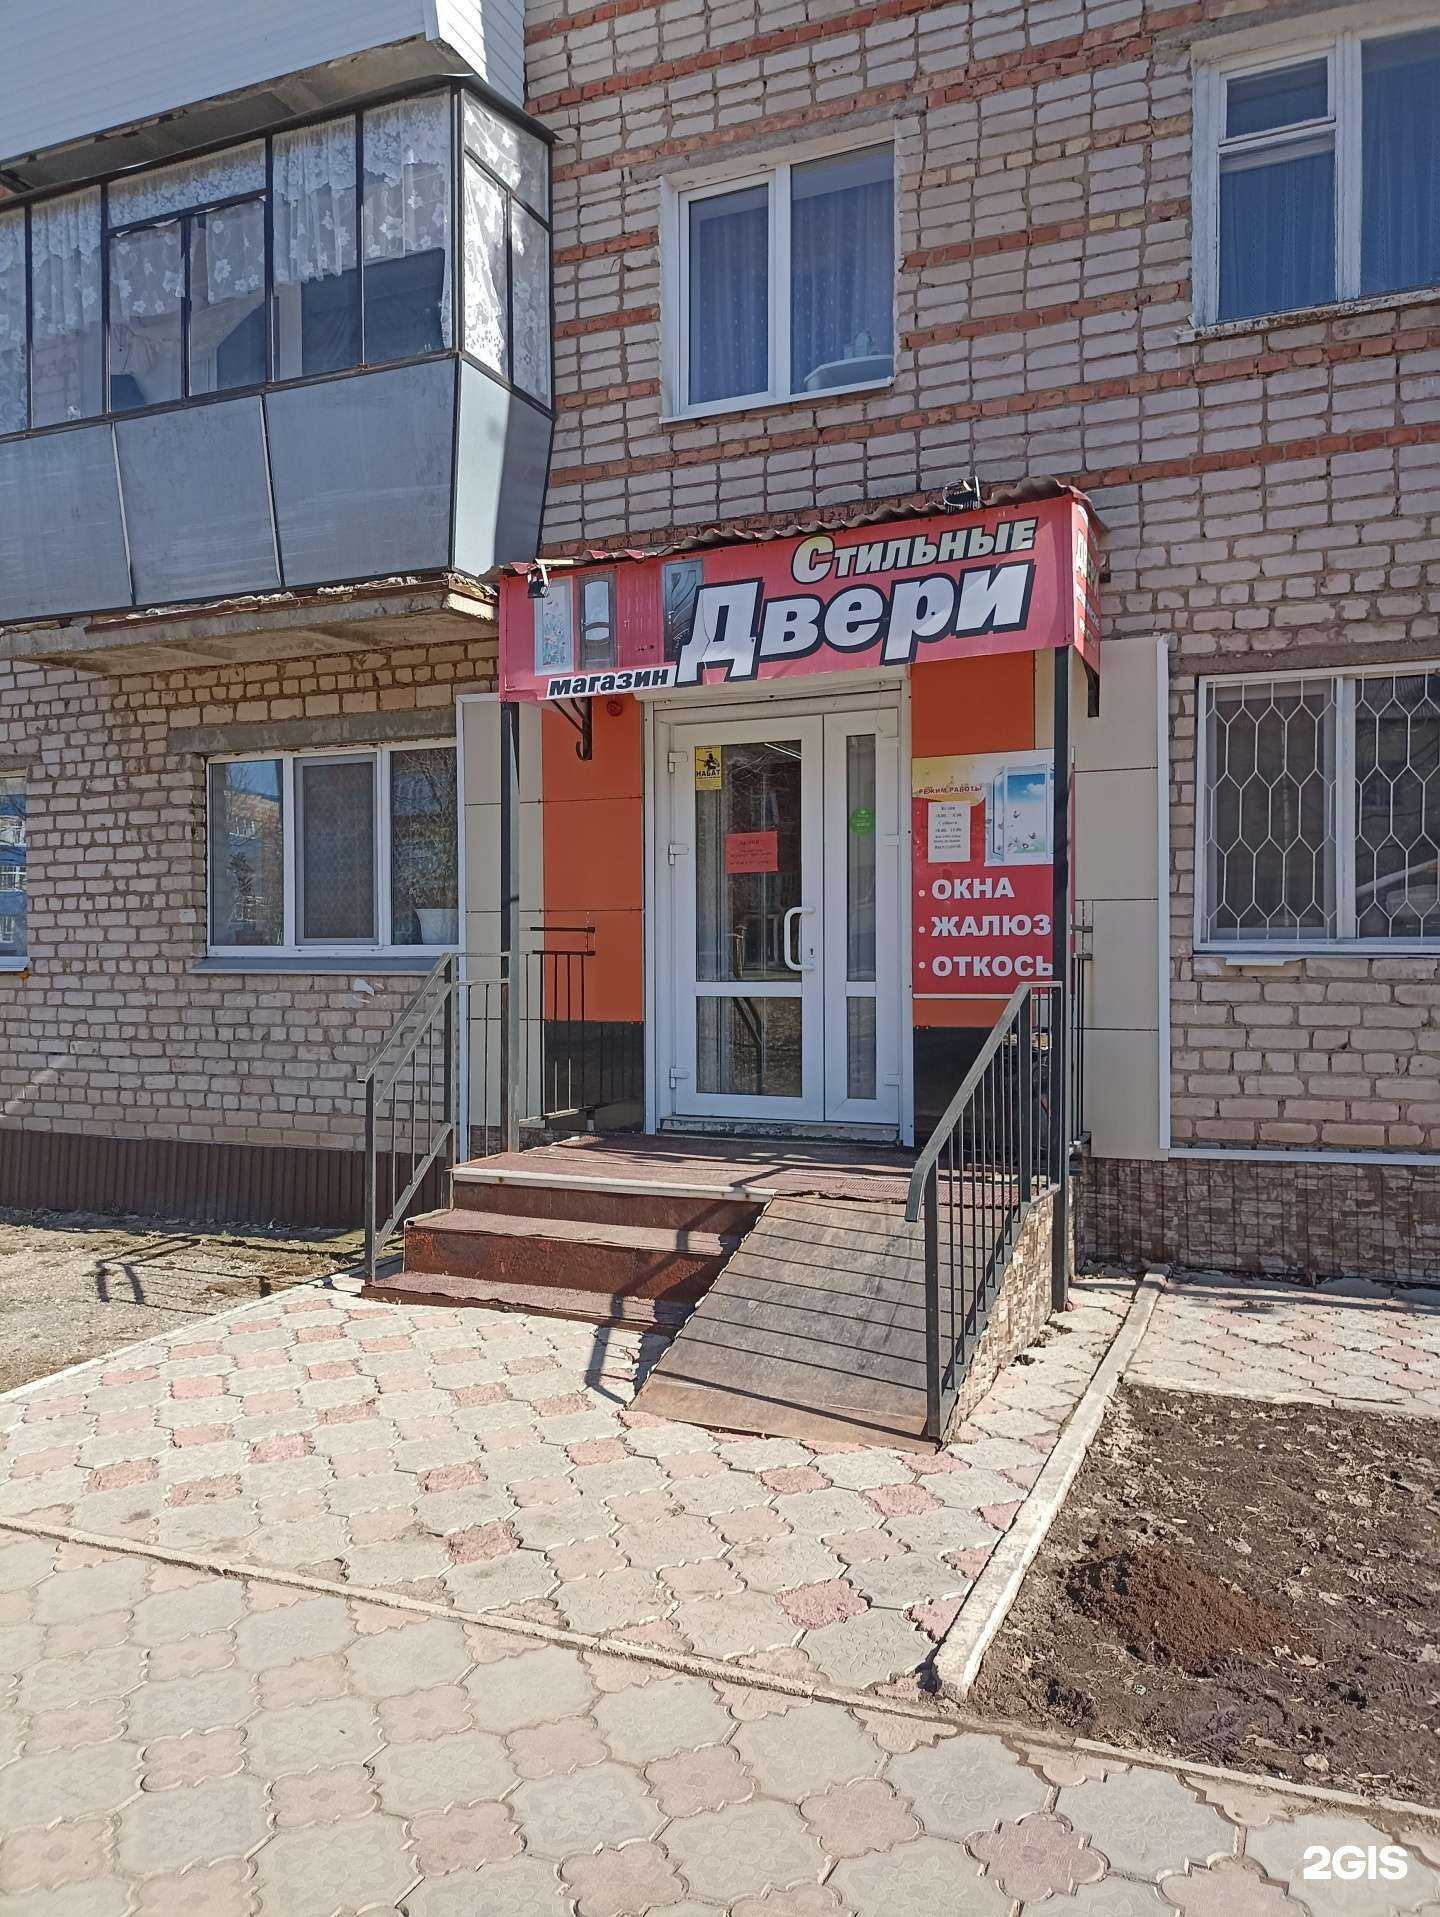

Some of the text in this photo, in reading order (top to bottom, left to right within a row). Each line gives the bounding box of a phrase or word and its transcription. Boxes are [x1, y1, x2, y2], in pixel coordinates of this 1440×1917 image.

[674, 560, 1035, 686] Двери
[549, 669, 669, 696] магазин
[918, 785, 982, 795] РЕЖИМ РАБОТЫ
[931, 877, 1015, 900] ОКНА
[931, 914, 1051, 937] ЖАЛЮЗ
